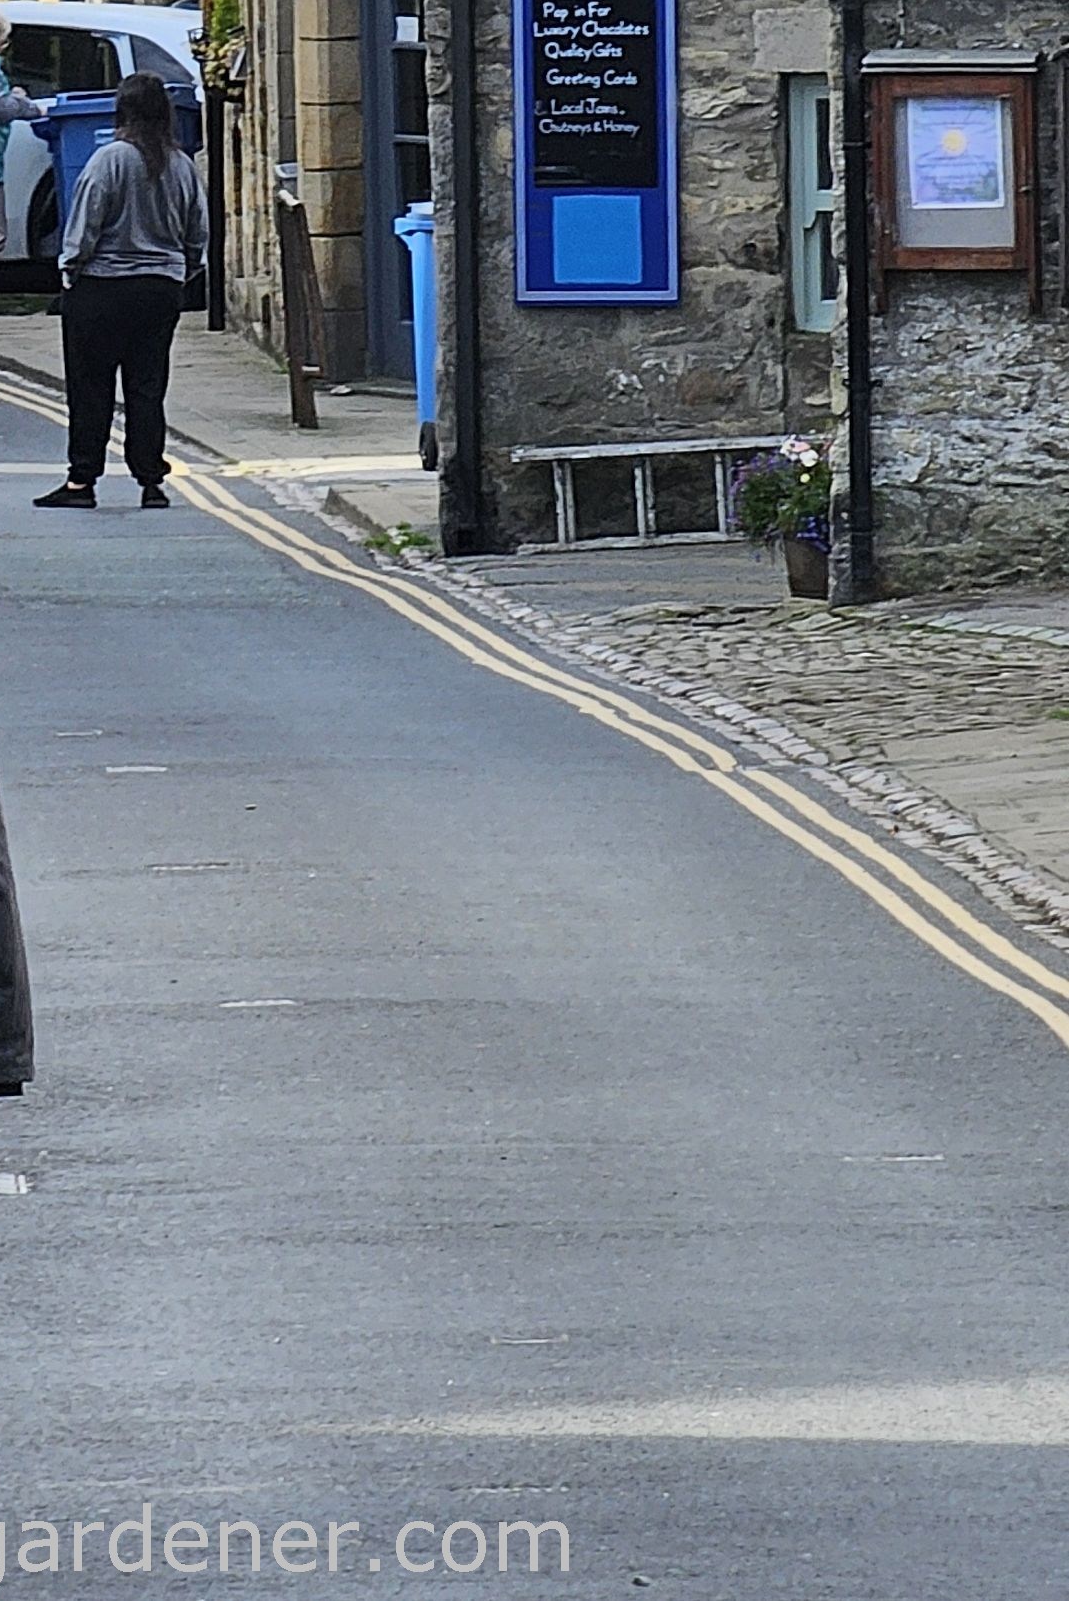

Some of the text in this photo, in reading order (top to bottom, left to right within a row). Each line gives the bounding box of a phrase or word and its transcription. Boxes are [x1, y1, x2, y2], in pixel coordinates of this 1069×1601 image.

[543, 1, 612, 22] Pop in For
[533, 20, 650, 40] Luxury Chocolates
[544, 41, 623, 62] Quality Gifts
[546, 68, 638, 89] Greeting Cards
[550, 98, 585, 116] Local
[538, 118, 641, 138] Chutneys & Honey
